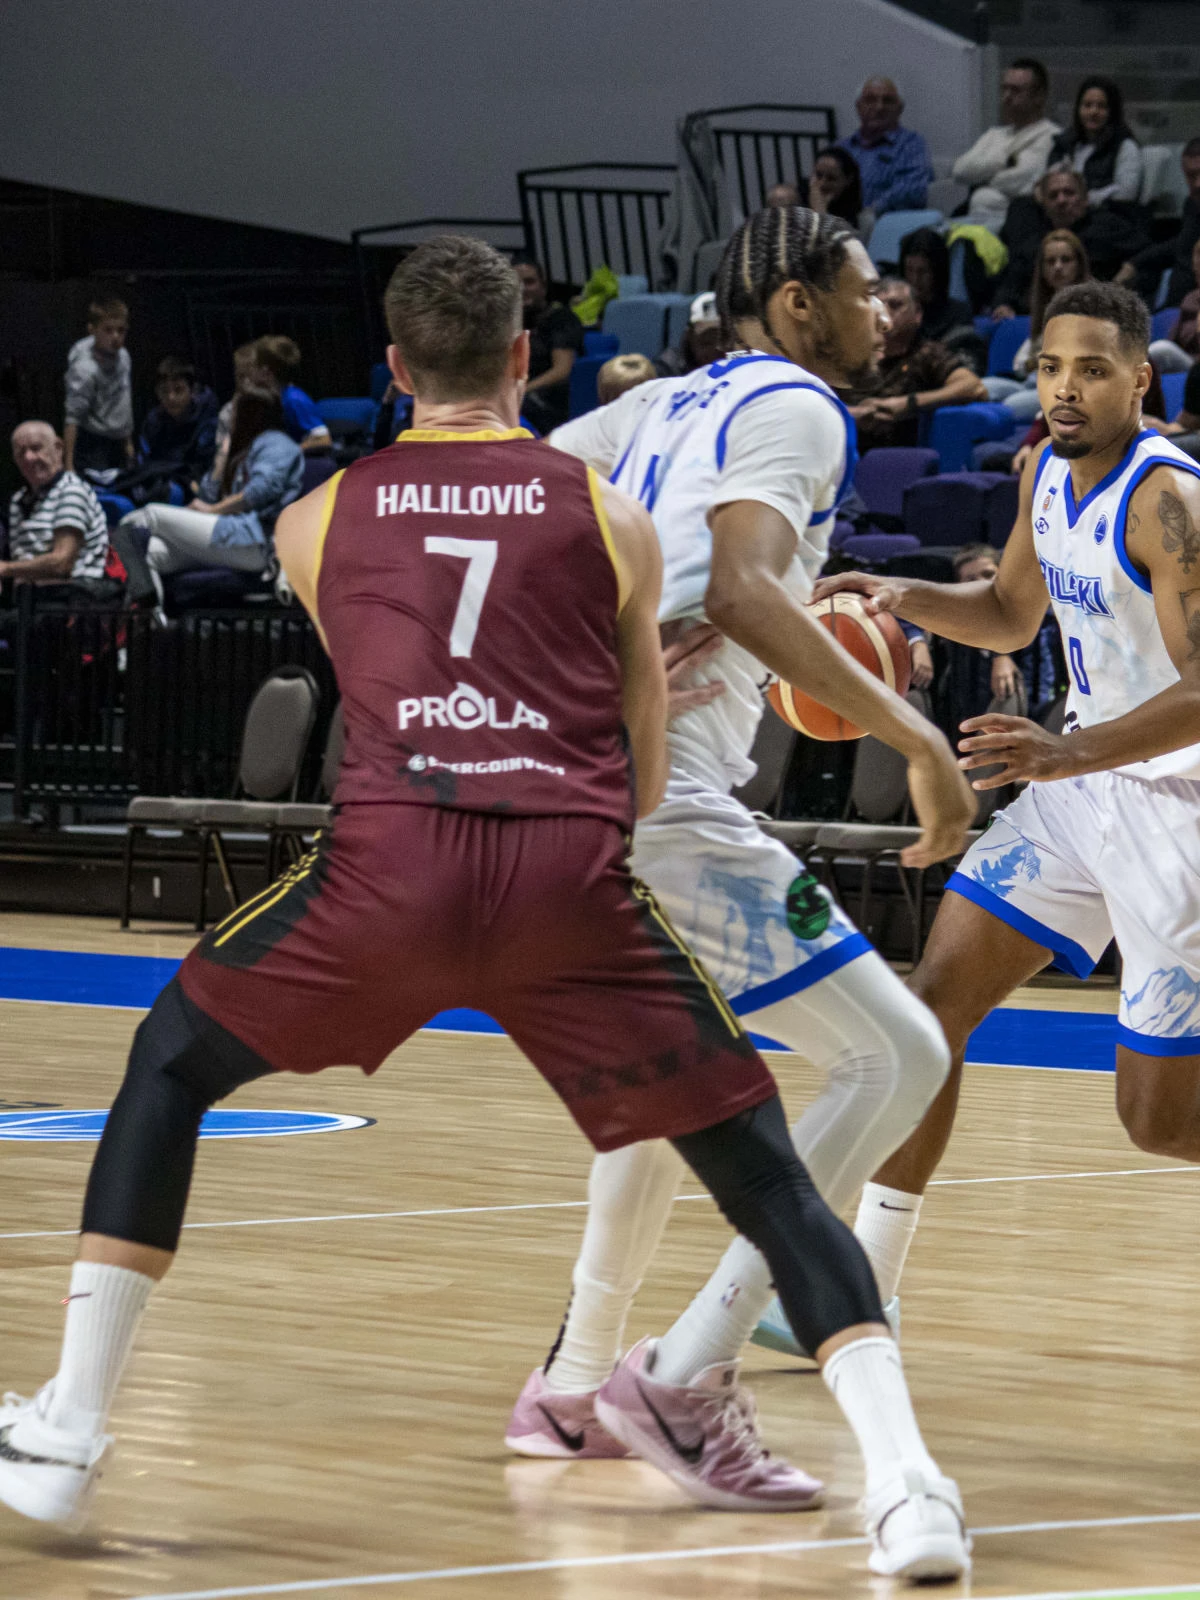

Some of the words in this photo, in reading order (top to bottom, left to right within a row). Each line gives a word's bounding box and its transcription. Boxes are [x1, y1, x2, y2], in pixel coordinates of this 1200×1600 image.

[376, 478, 546, 517] HALILOVIĆ
[424, 535, 498, 658] 7
[1069, 636, 1091, 696] 0
[427, 755, 565, 776] EERGOINV
